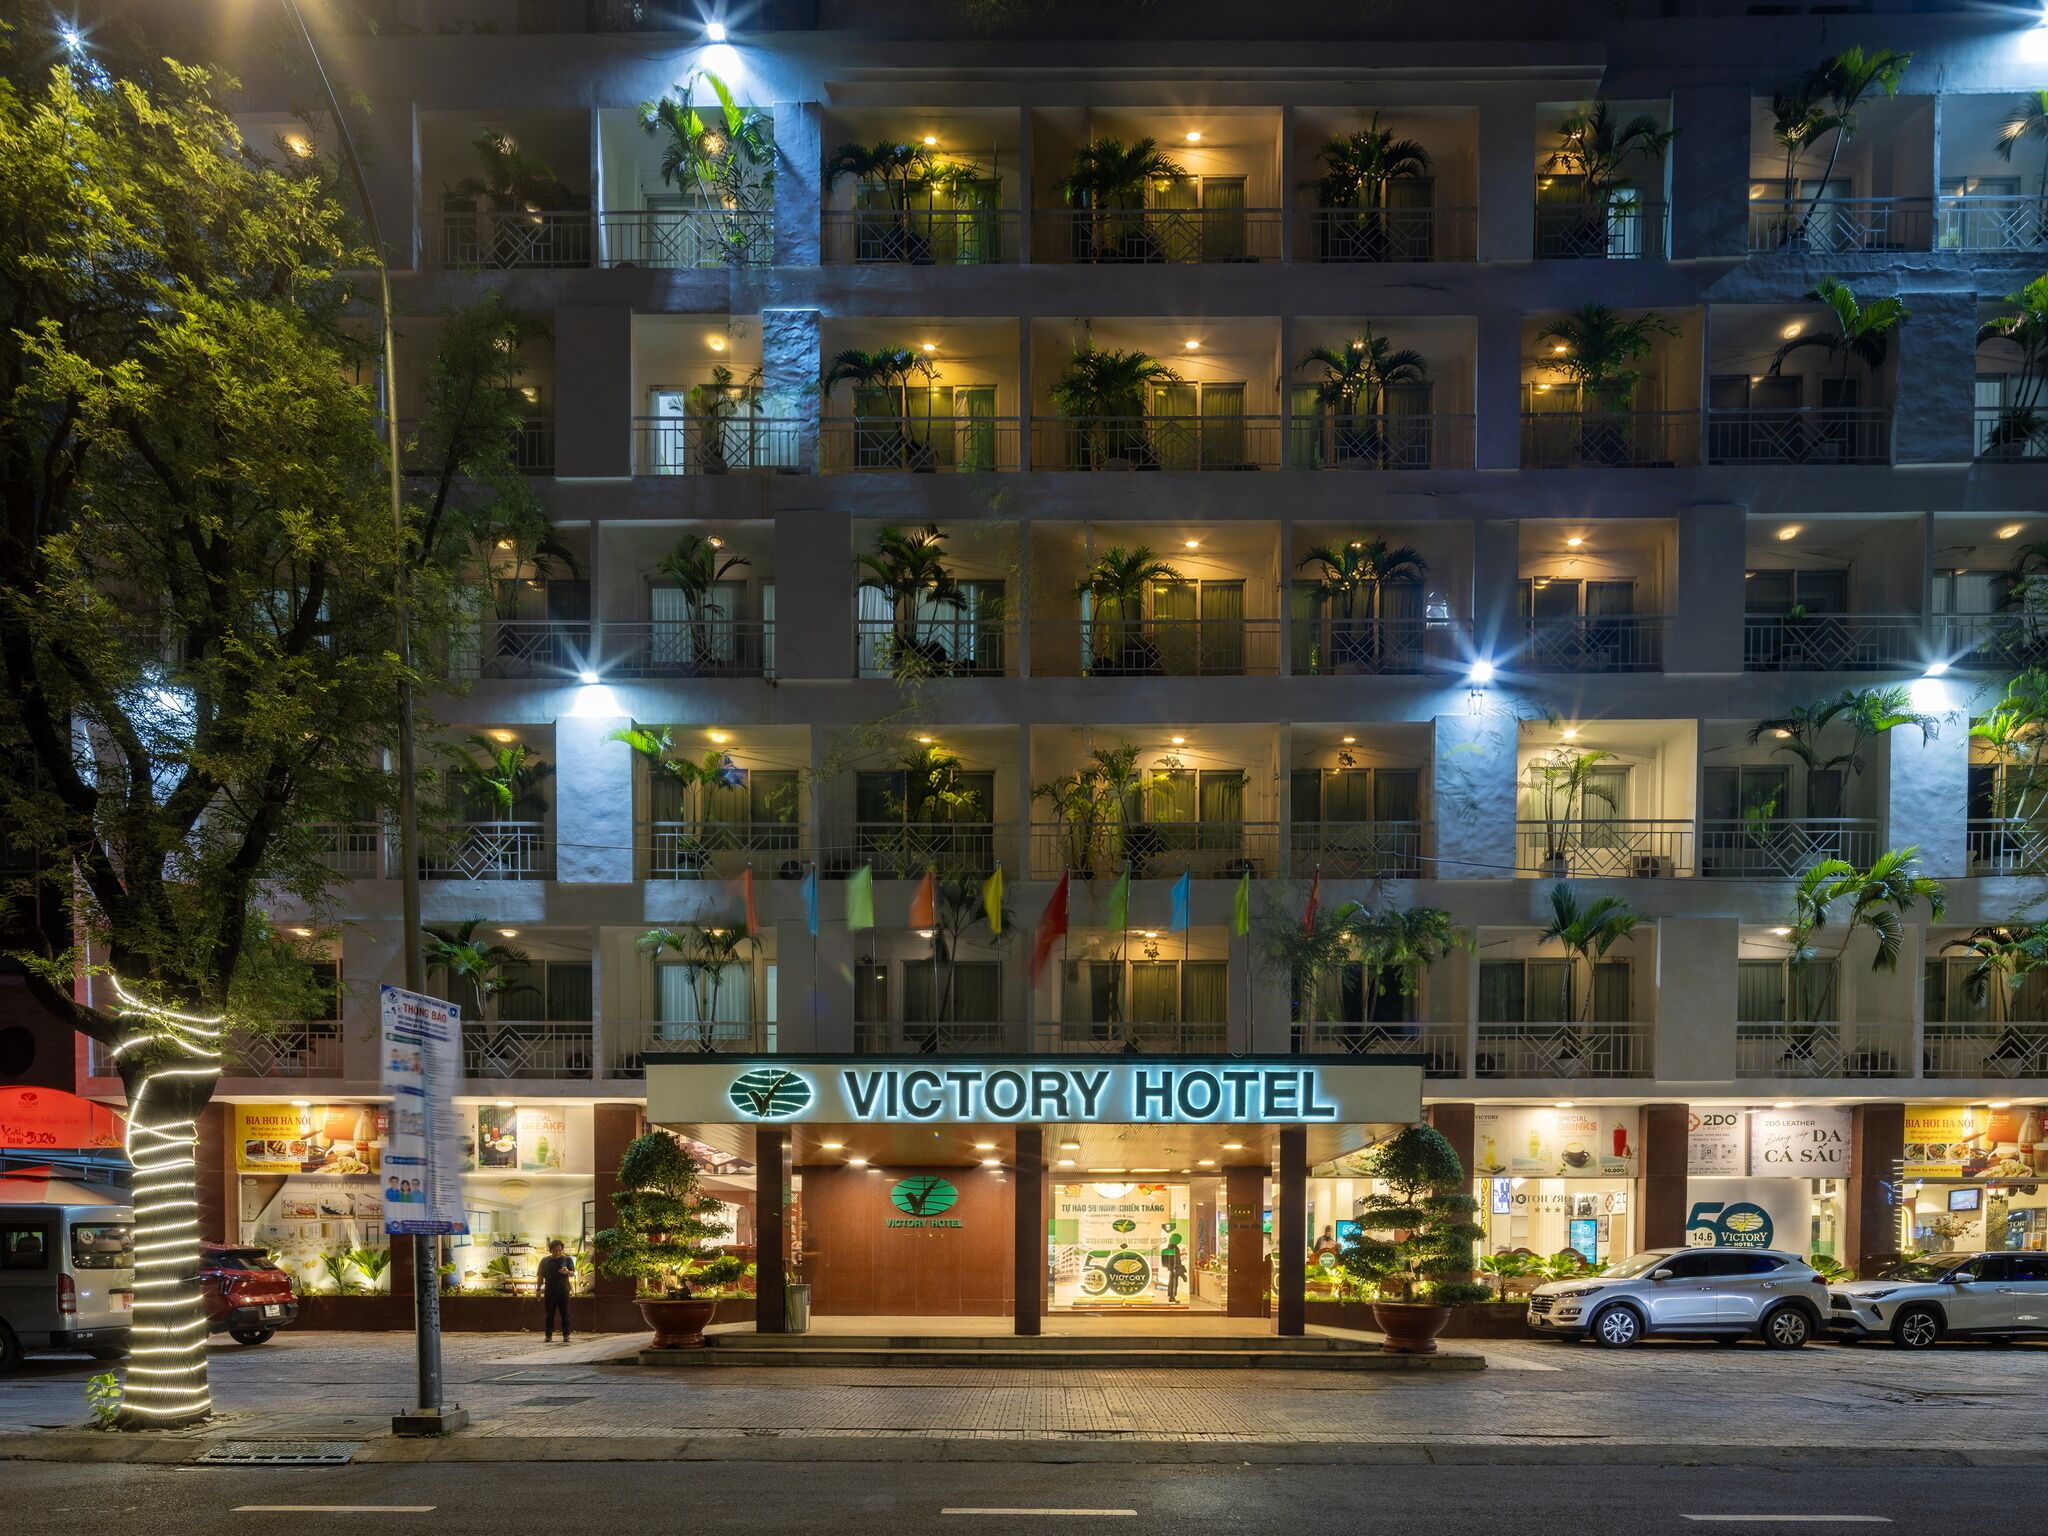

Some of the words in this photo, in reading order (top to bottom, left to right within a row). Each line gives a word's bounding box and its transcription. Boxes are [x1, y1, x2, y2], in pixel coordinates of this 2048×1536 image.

[403, 1003, 429, 1018] THÔNG
[431, 1010, 447, 1023] BÁO
[843, 1069, 1110, 1119] VICTORY
[1134, 1069, 1336, 1119] HOTEL
[246, 1117, 262, 1125] BIA
[263, 1117, 279, 1125] HƠI
[281, 1114, 293, 1125] HÀ
[295, 1114, 312, 1126] NỘI
[1703, 1114, 1737, 1126] 2DO
[1905, 1119, 1920, 1128] BIA
[1942, 1116, 1955, 1128] HÀ
[1557, 1122, 1597, 1131] DRINKS
[1813, 1129, 1842, 1142] DA
[1764, 1145, 1793, 1163] CÁ
[1800, 1142, 1842, 1163] SẤU
[1062, 1203, 1071, 1214] TỰ
[1088, 1204, 1097, 1212] 50
[886, 1218, 927, 1229] VICTORY
[931, 1218, 964, 1229] HOTEL
[1686, 1202, 1774, 1249] 50
[1692, 1232, 1713, 1241] 14.6
[1721, 1232, 1768, 1242] VICTORY
